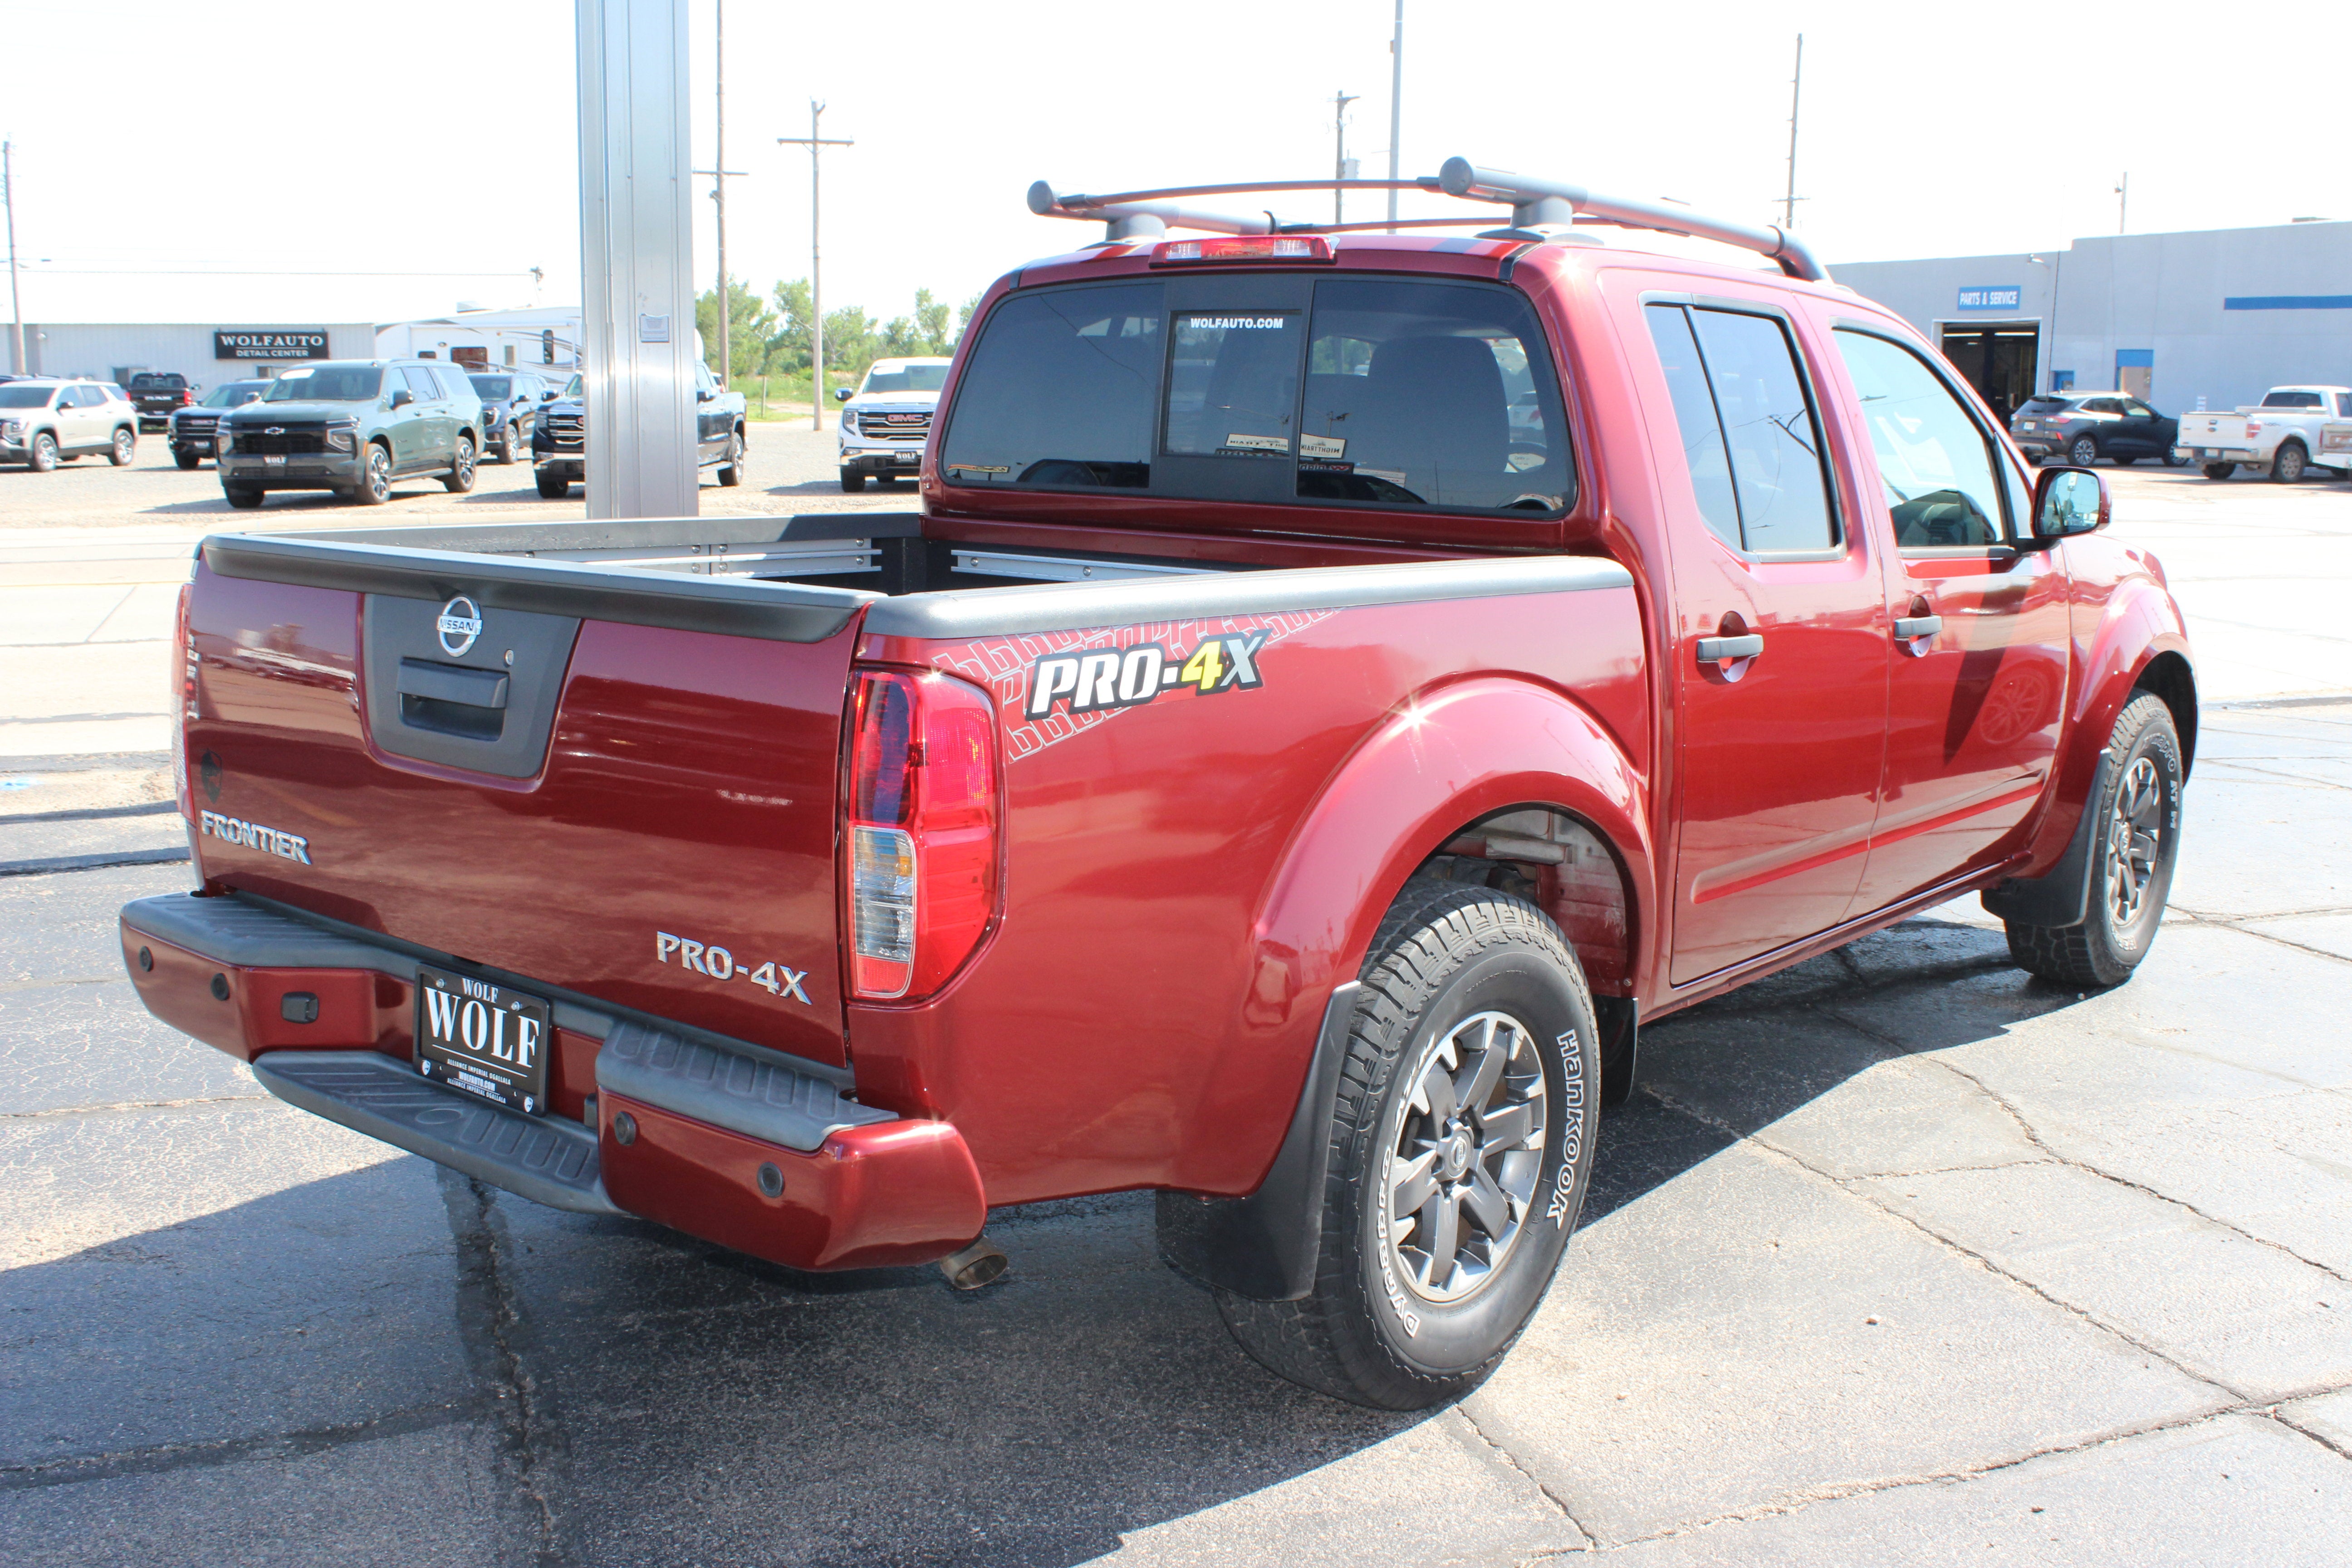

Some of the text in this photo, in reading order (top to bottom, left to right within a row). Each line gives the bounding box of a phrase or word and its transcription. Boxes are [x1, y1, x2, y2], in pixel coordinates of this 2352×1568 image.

[1960, 291, 2018, 305] PARTS & SERVICE
[1191, 318, 1284, 329] WOLFAUTO.COM
[220, 335, 324, 347] WOLFAUTO
[887, 414, 924, 422] GMC
[440, 618, 475, 632] NISSAN
[1029, 634, 1264, 716] PRO-4X
[201, 809, 312, 865] FRONTIER
[656, 931, 813, 1005] PRO-4X
[462, 977, 499, 1004] WOLF
[424, 986, 540, 1068] WOLF
[447, 1058, 511, 1085] ALLIANCE IMPERIAL OGALLALA
[458, 1071, 496, 1092] WOLFAUTO.COM
[447, 1078, 506, 1104] ALLIANCE IMPERIAL OGALLALA
